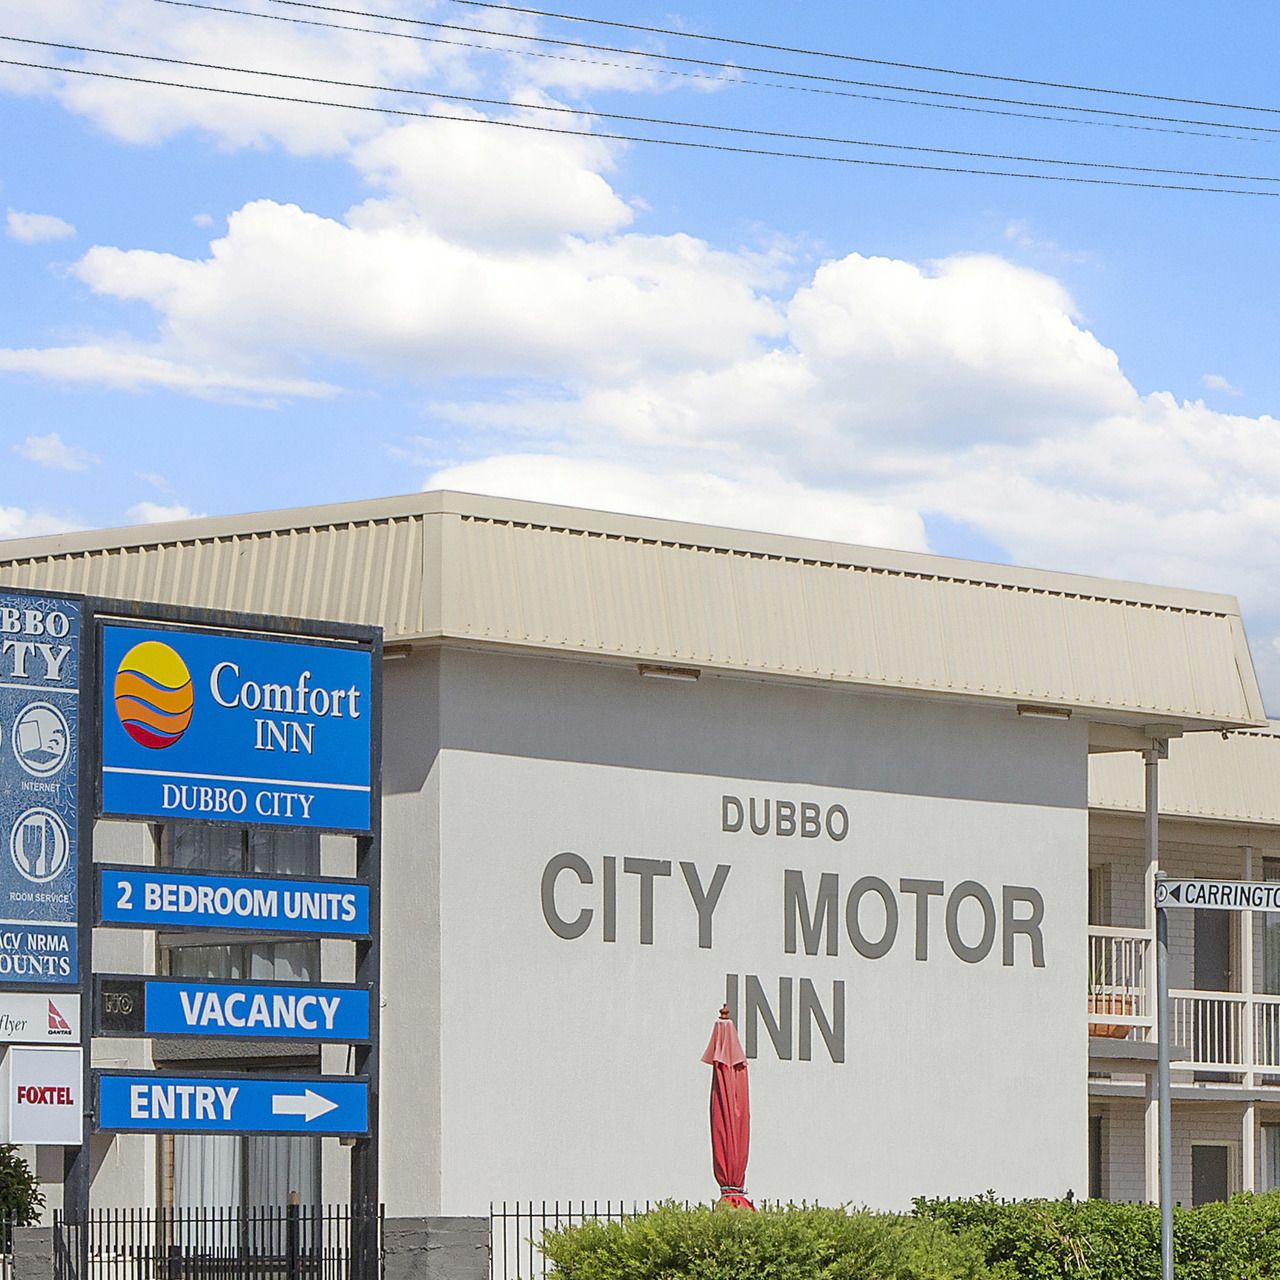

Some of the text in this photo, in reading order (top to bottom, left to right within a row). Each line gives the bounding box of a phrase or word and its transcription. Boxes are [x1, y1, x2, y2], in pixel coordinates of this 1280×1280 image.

[210, 661, 361, 719] Comfort
[254, 718, 315, 754] INN
[21, 781, 60, 792] INTERNET
[162, 784, 315, 819] DUBBO CITY
[722, 795, 849, 842] DUBBO
[10, 892, 69, 903] ROOM SERVICE
[116, 881, 357, 922] 2 BEDROOM UNITS
[541, 852, 1046, 968] CITY MOTOR
[27, 934, 69, 952] NRMA
[179, 991, 341, 1030] VACANCY
[726, 973, 845, 1064] INN
[17, 1086, 74, 1105] FOXTEL
[130, 1085, 239, 1121] ENTRY
